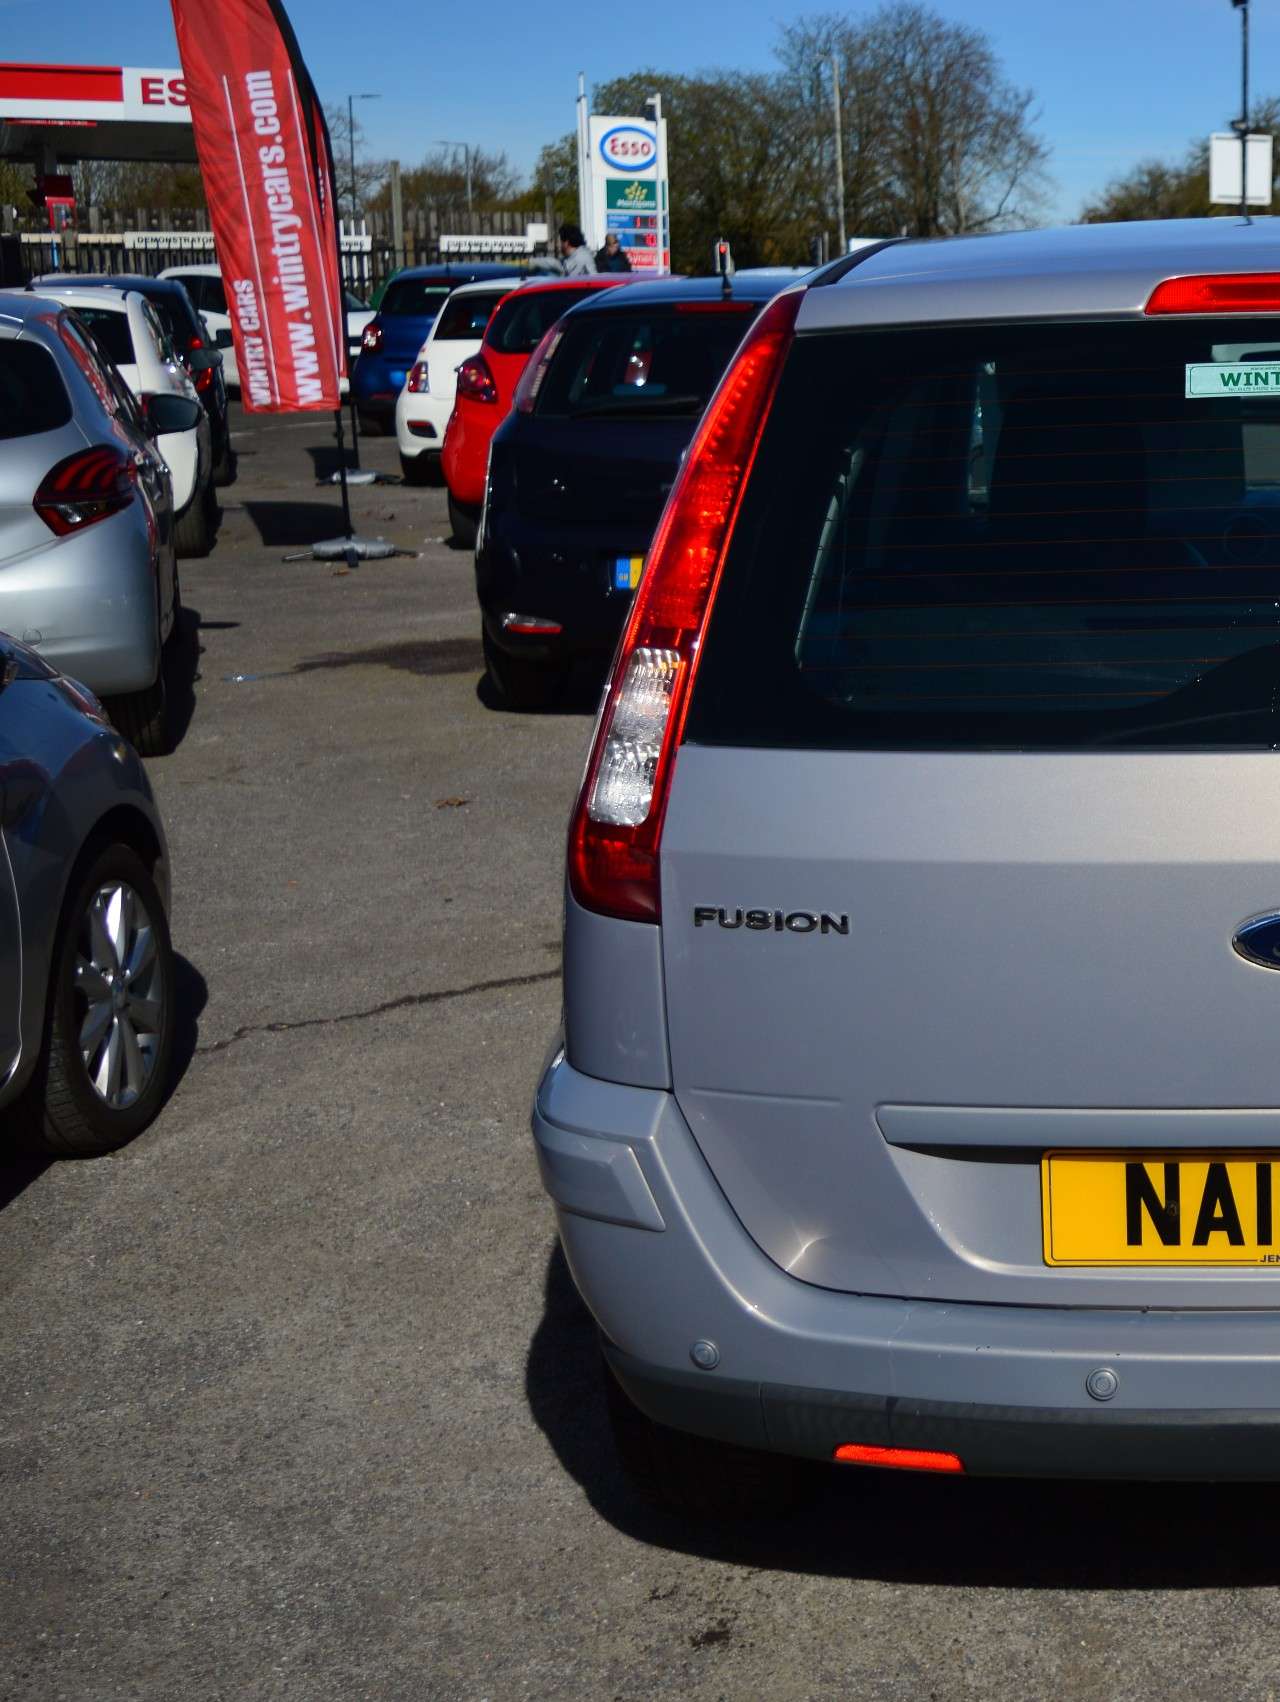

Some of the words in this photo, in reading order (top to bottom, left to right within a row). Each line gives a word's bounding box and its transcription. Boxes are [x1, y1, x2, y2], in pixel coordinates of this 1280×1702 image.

[244, 69, 324, 406] www.wintrycars.com
[233, 279, 261, 333] CARS
[244, 335, 272, 407] WINTRY
[694, 906, 850, 935] FUSION
